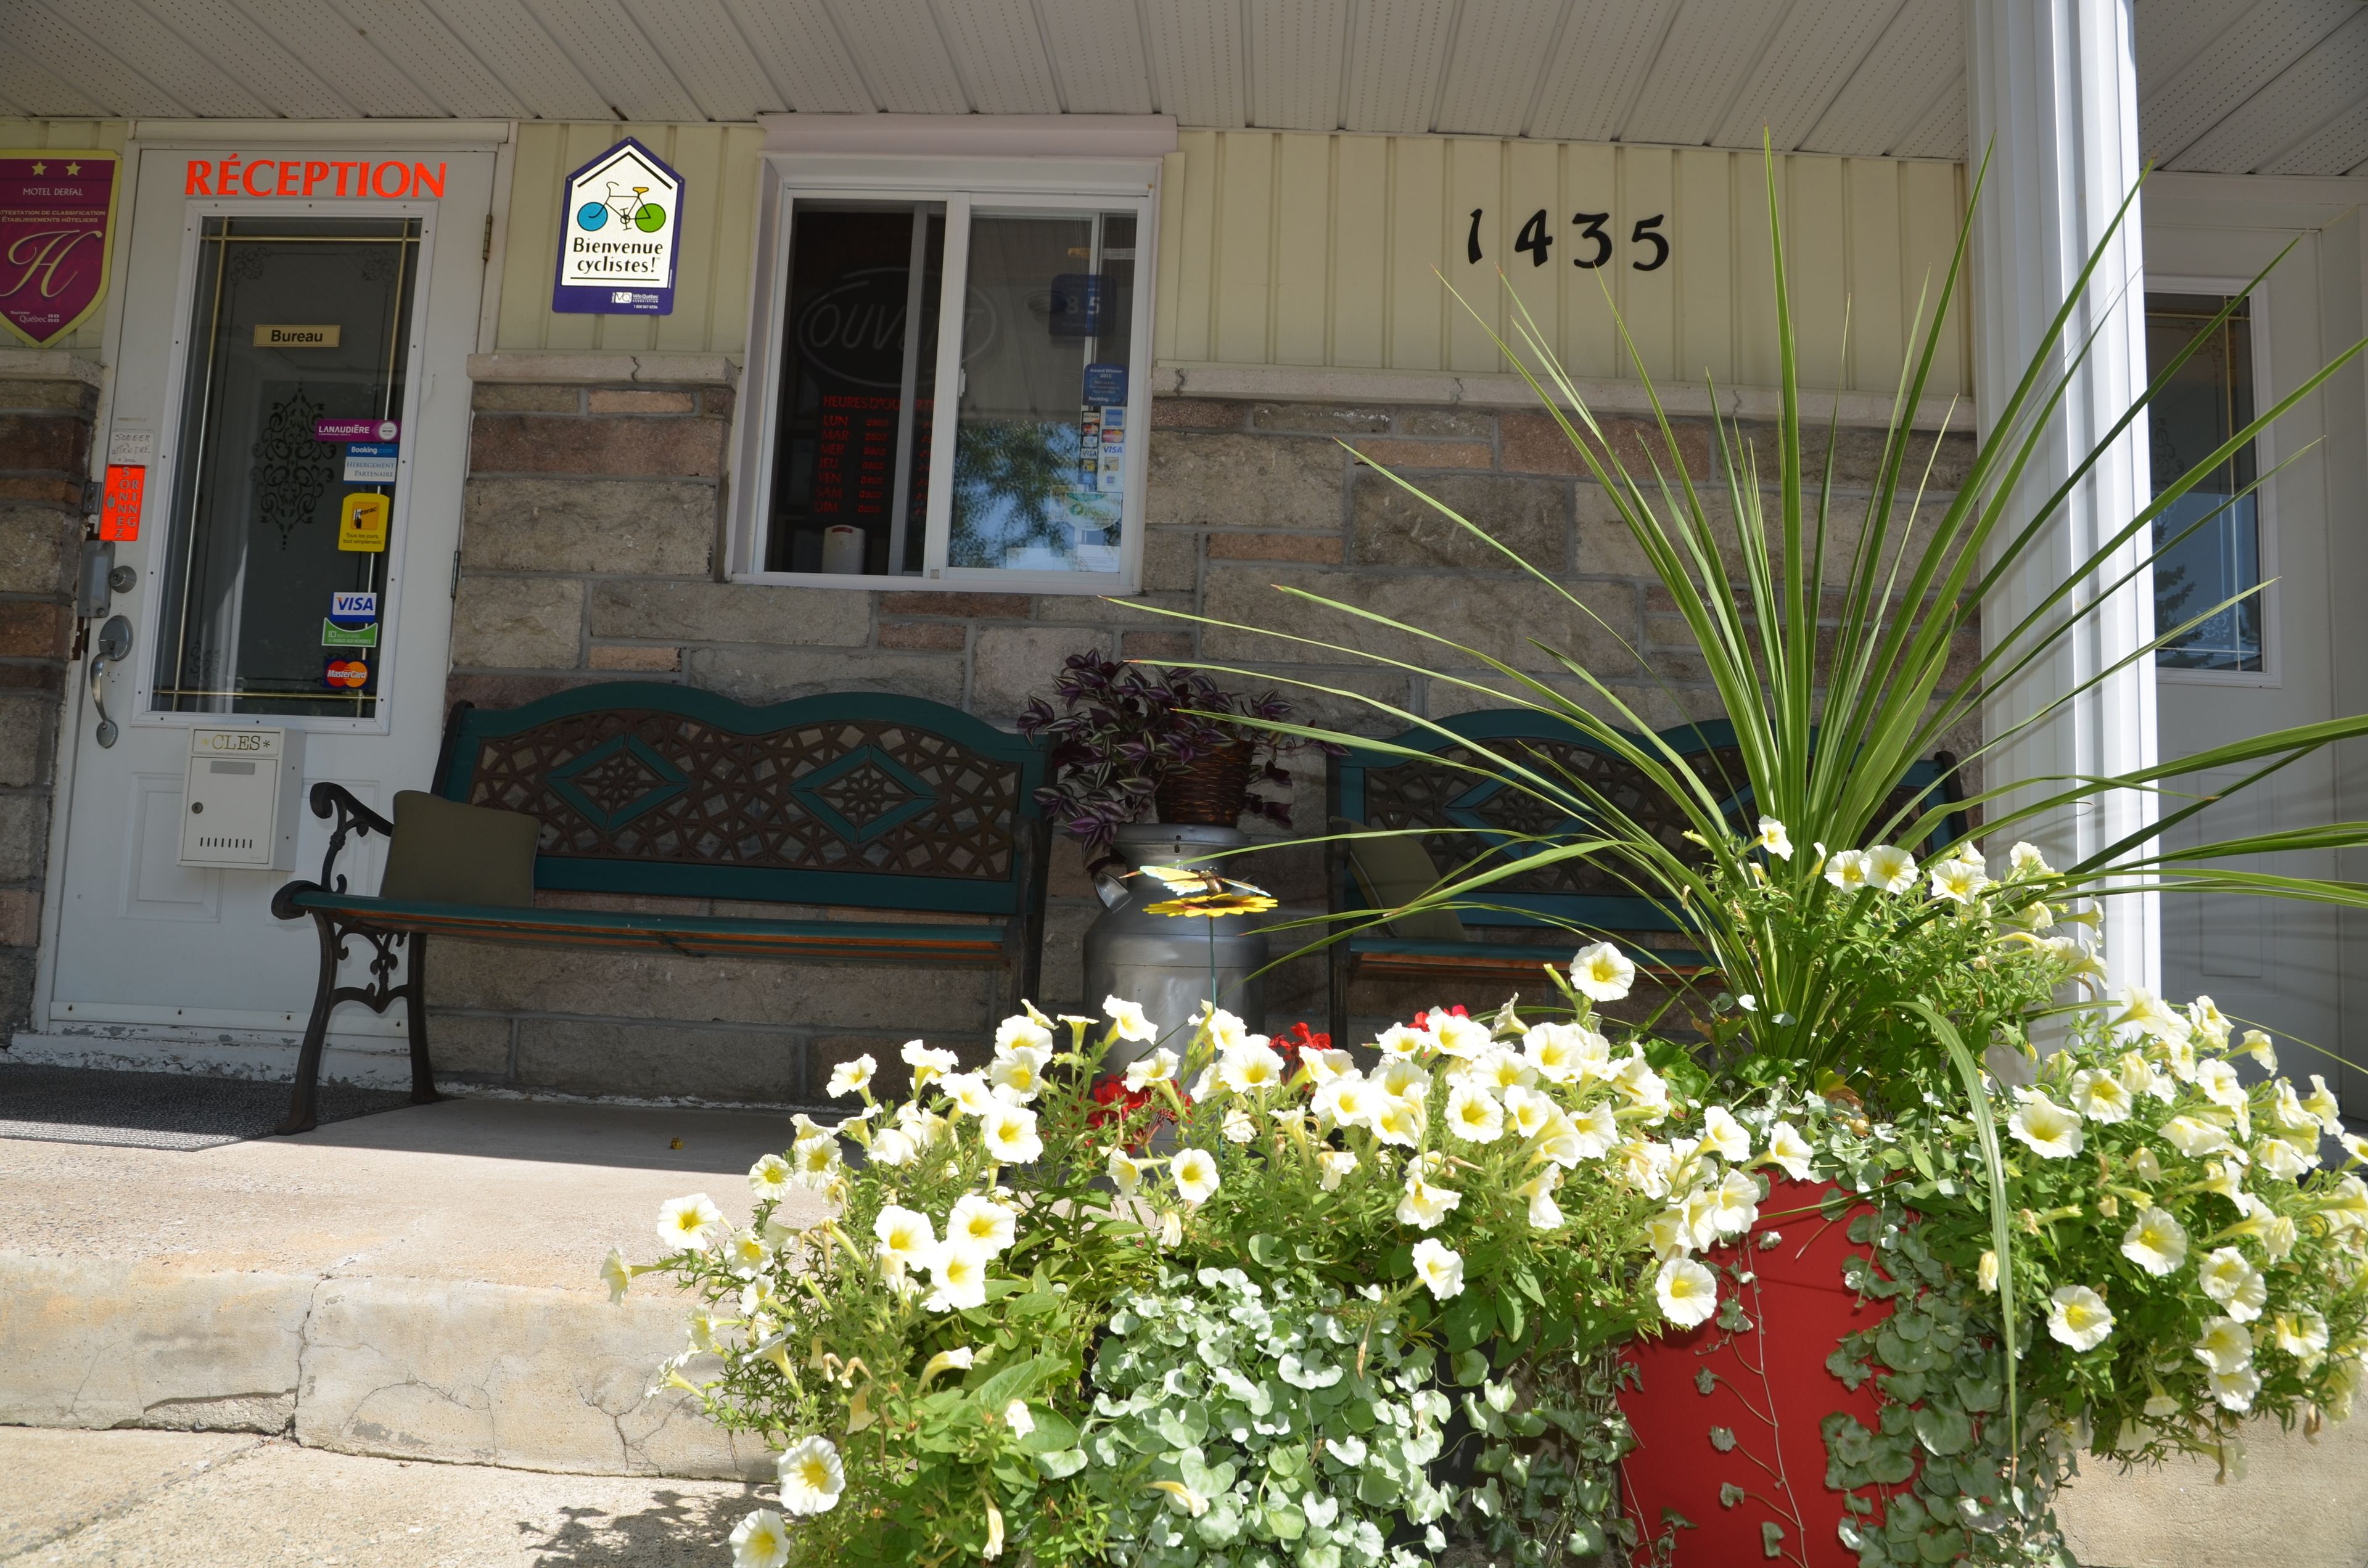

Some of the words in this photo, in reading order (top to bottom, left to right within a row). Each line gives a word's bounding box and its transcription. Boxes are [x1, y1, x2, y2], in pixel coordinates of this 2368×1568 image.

[185, 153, 446, 198] RÉCEPTION
[23, 187, 51, 195] MOTEL
[54, 187, 83, 196] DERFAL
[1468, 208, 1669, 271] 1435
[573, 237, 664, 255] Bienvenue
[577, 256, 656, 274] cyclistes!
[20, 315, 46, 323] Québec
[271, 330, 323, 342] Bureau
[823, 395, 868, 409] HEURES
[823, 414, 849, 427] LUN
[821, 429, 849, 441] MAR
[351, 446, 393, 454] Booking.com
[820, 443, 844, 454] MER
[1103, 446, 1123, 454] VISA
[819, 458, 839, 469] JEU
[819, 472, 842, 483] VEN
[814, 501, 839, 513] DIM
[336, 597, 373, 610] VISA
[327, 669, 367, 679] MasterCard
